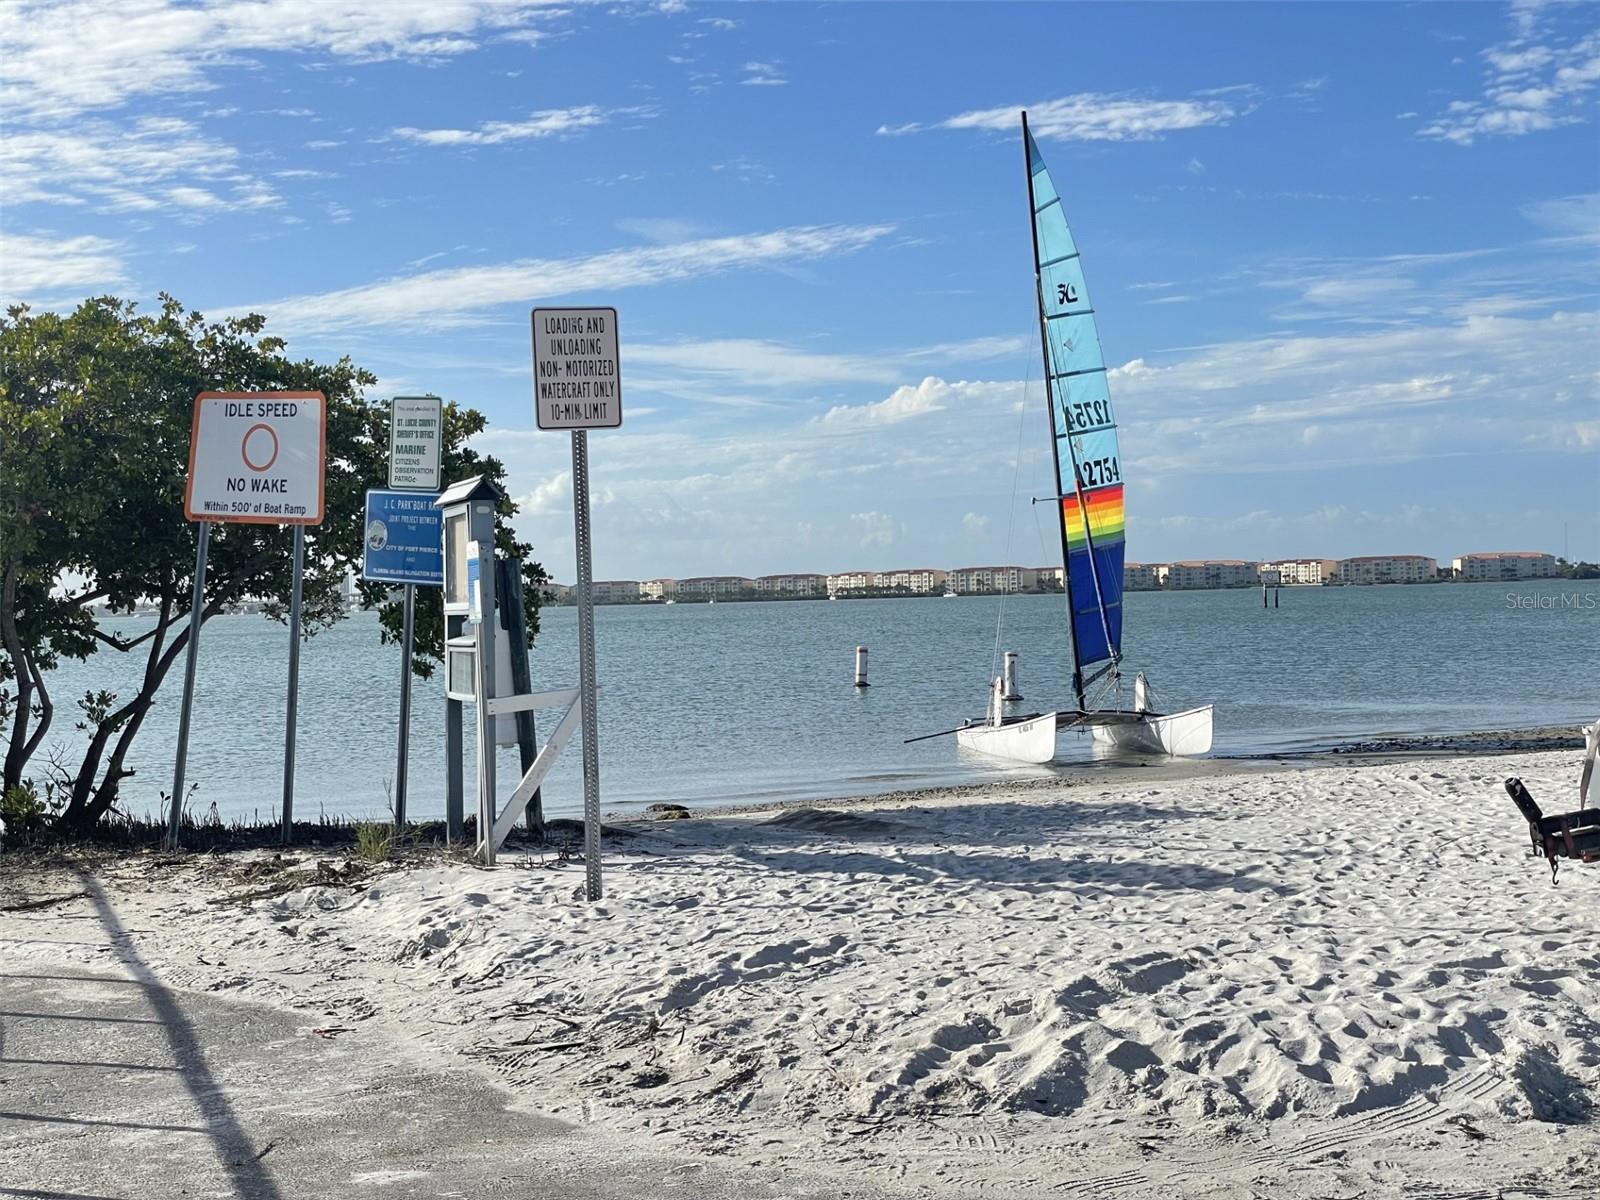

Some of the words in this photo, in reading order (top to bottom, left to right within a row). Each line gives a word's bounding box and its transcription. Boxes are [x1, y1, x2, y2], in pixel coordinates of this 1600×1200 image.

[587, 317, 605, 333] AND
[551, 338, 602, 356] UNLOADING
[566, 360, 614, 377] MOTORIZED
[540, 382, 590, 399] WATERCRAFT
[593, 381, 615, 398] ONLY
[225, 403, 254, 417] IDLE
[258, 403, 298, 417] SPEED
[585, 402, 607, 420] LIMIT
[419, 419, 436, 428] COUNTY
[420, 430, 434, 440] OFFICE
[395, 444, 426, 455] MARINE
[395, 458, 420, 466] CITIZENS
[395, 467, 434, 475] OBSERVATION
[227, 478, 246, 492] NO
[251, 478, 288, 493] WAKE
[204, 501, 229, 512] Within
[231, 502, 252, 512] 500'
[254, 502, 262, 513] of
[264, 503, 282, 514] Boat
[284, 503, 306, 516] Ramp
[397, 500, 411, 510] PARK
[413, 500, 427, 511] BOAT
[419, 516, 438, 525] BETWEEN
